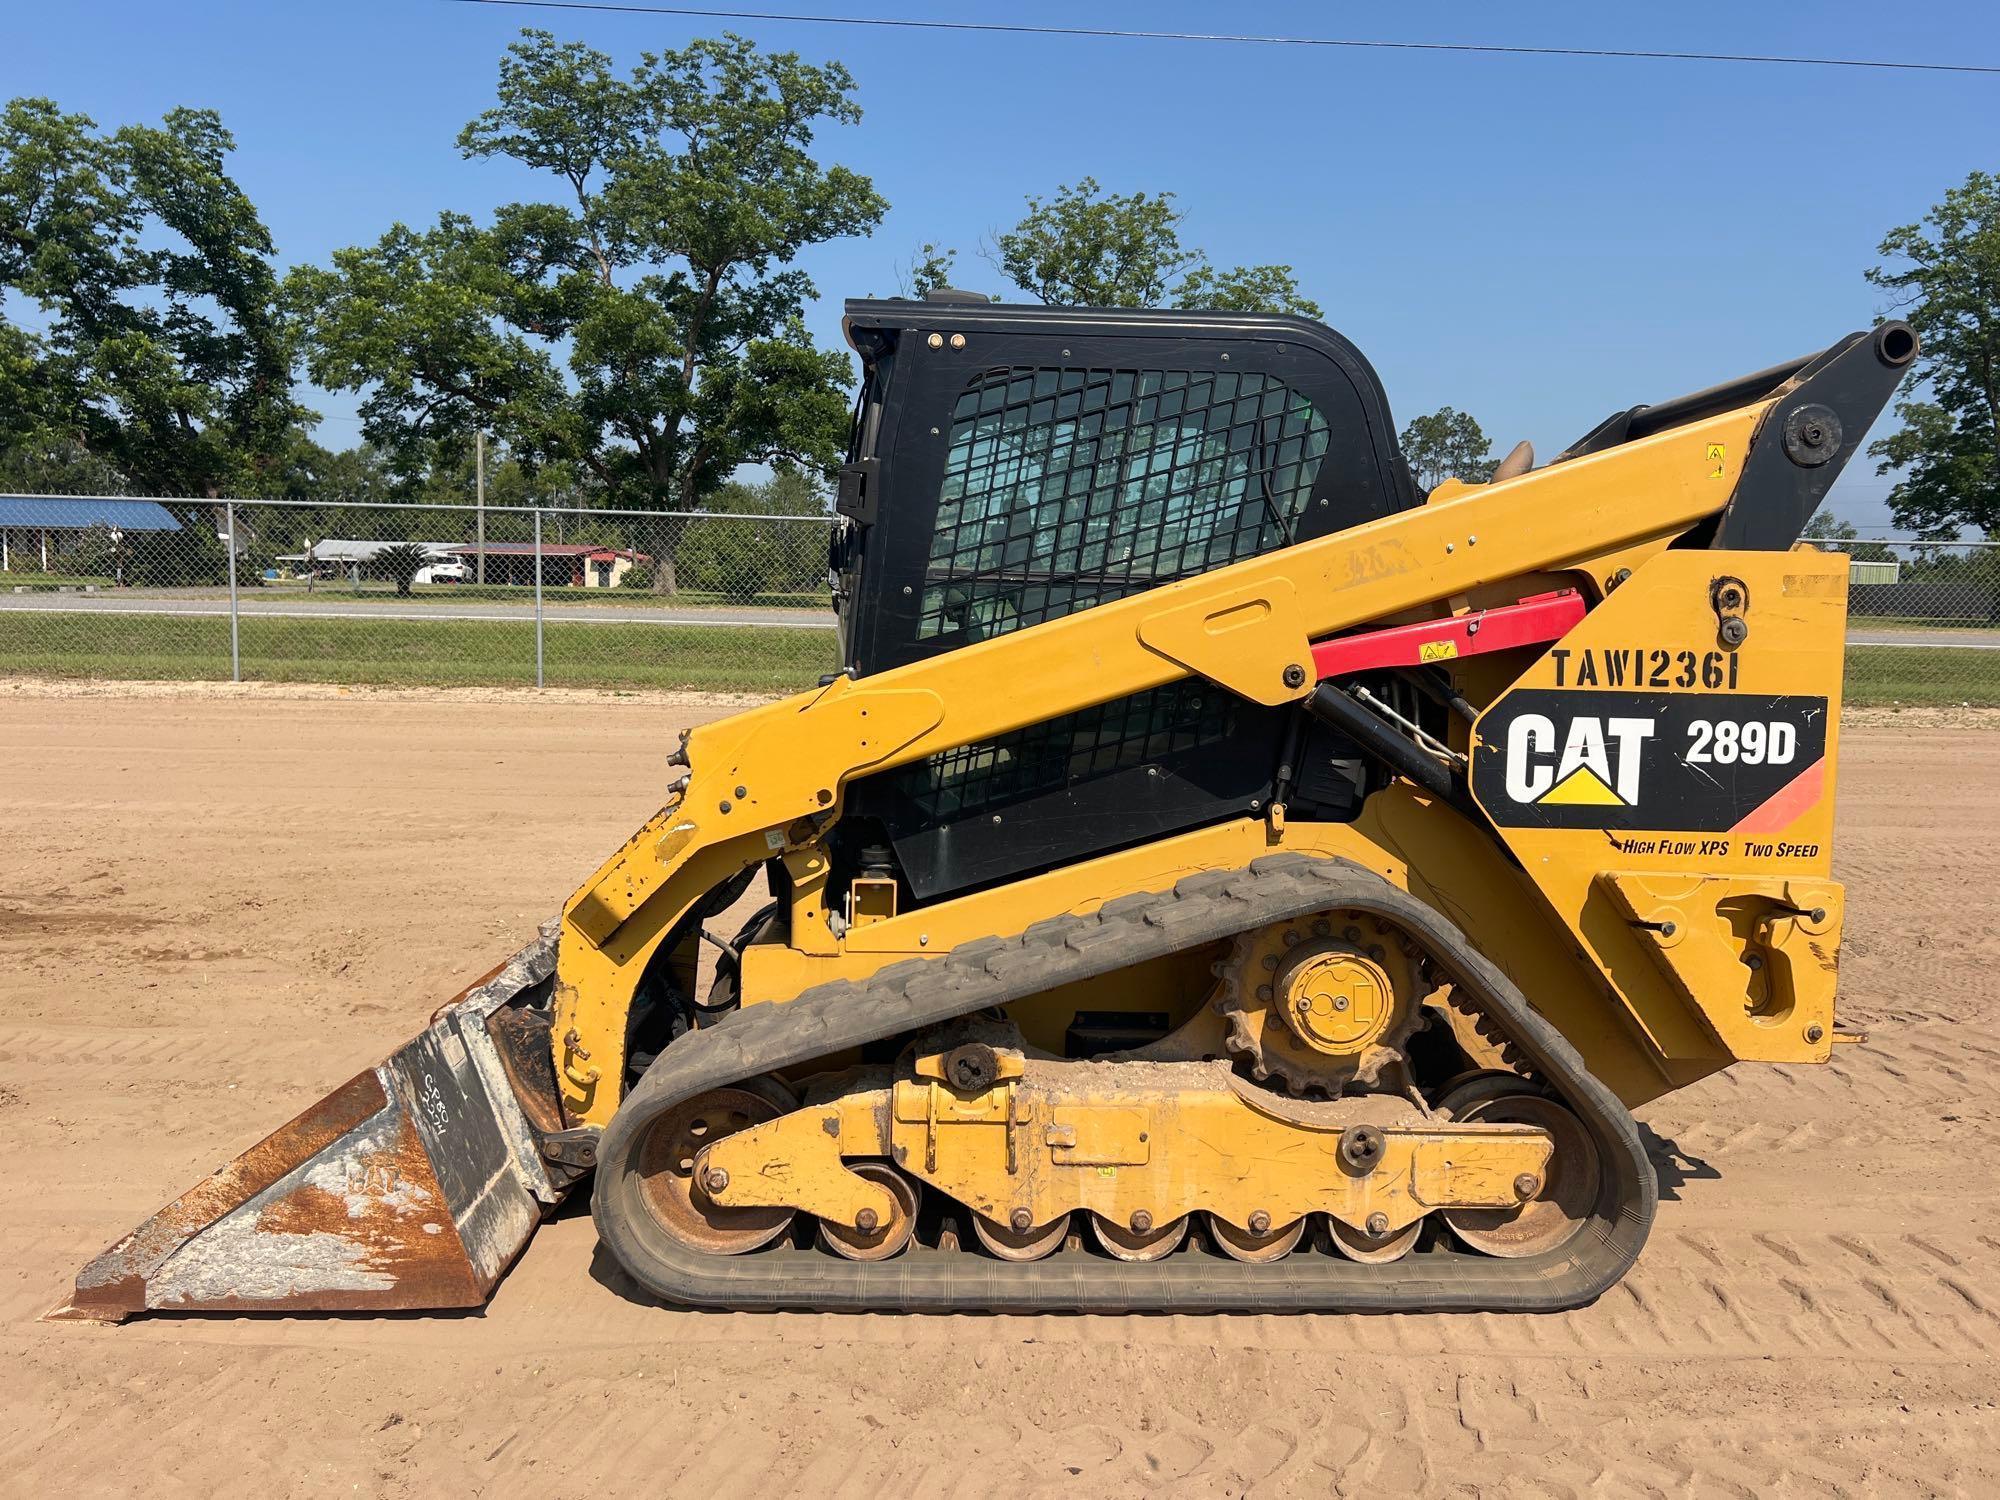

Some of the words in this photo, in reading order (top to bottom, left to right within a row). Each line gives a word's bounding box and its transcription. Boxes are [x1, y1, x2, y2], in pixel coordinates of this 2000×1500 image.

[1505, 713, 1655, 806] CAT
[1685, 720, 1796, 765] 289D
[1698, 840, 1730, 857] XPS
